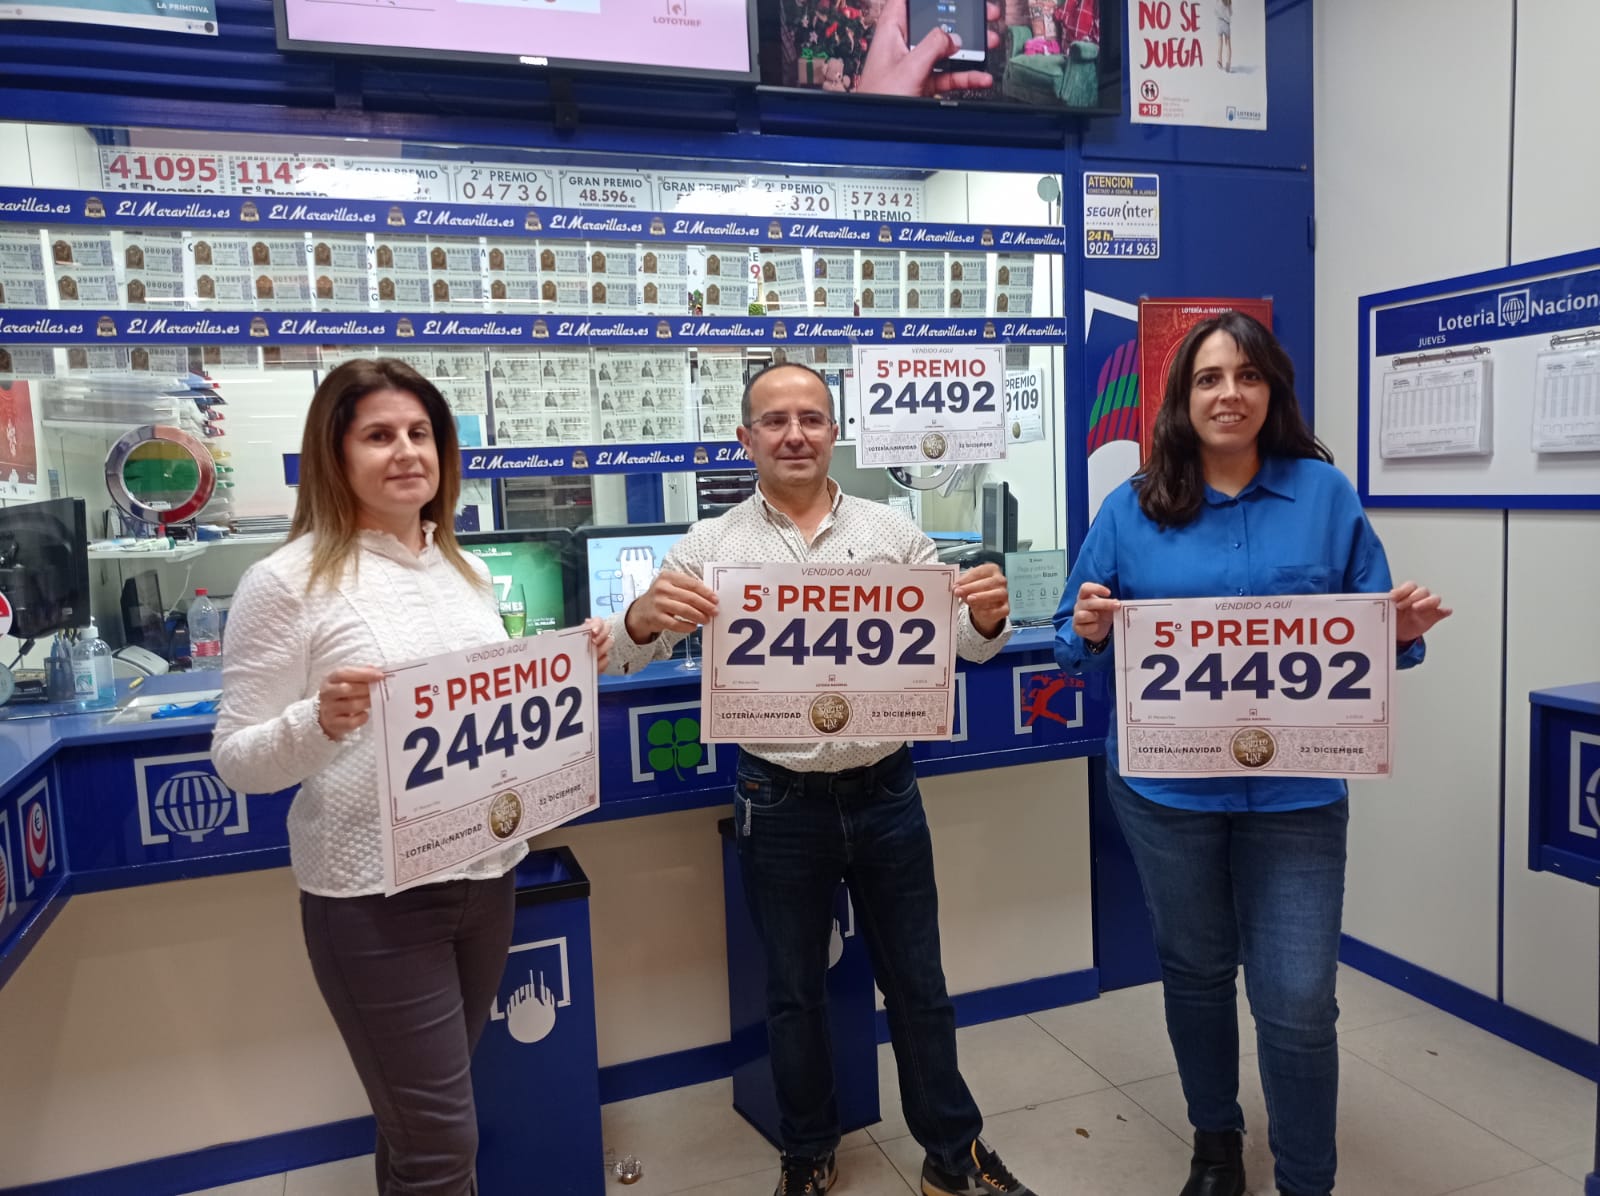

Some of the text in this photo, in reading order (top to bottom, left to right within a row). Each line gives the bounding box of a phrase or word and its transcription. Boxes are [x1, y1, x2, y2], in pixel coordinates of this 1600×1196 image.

[169, 3, 209, 14] PRIMITIVA
[1138, 0, 1201, 32] NO SE
[653, 16, 701, 27] LOTOTURF
[1140, 37, 1203, 69] JUEGA
[1141, 105, 1159, 115] +18
[109, 154, 217, 182] 41095
[490, 171, 538, 184] PREMIO
[569, 176, 642, 189] GRAN PREMIO
[1088, 176, 1133, 188] ATENCION
[463, 182, 548, 202] 04736
[662, 182, 695, 192] GRAN
[579, 189, 629, 203] 48.596
[851, 191, 913, 207] 57342
[116, 201, 231, 218] El Maravillas.es
[269, 205, 376, 223] El Maravillas.es
[864, 210, 912, 222] PREMIO
[414, 210, 515, 228] El Maravillas.es
[550, 215, 642, 233] El Maravillas.es
[673, 220, 759, 236] El Maravillas.es
[789, 224, 870, 240] El Maravillas.es
[899, 228, 975, 243] El Maravillas.es
[1088, 231, 1101, 240] 24
[1000, 231, 1014, 244] El
[1089, 242, 1156, 255] 902 114 963
[127, 318, 240, 335] El Maravillas.es
[278, 320, 385, 335] El Maravillas.es
[422, 321, 522, 335] El Maravillas.es
[1438, 309, 1495, 332] Loteria
[557, 323, 649, 337] El Maravillas.es
[679, 323, 765, 337] El Maravillas.es
[794, 324, 874, 337] El Maravillas.es
[902, 324, 977, 337] El Maravillas.es
[1002, 323, 1015, 336] El
[1418, 335, 1446, 348] JUEVES
[898, 359, 986, 378] PREMIO
[1006, 374, 1036, 390] PREMIO
[869, 381, 996, 416] 24492
[468, 454, 564, 470] El Maravillas.es
[596, 450, 685, 466] El Maravillas.es
[716, 448, 730, 461] El
[801, 567, 872, 577] VENDIDO AQUÍ
[742, 584, 925, 613] 5º PREMIO
[1215, 600, 1293, 611] VENDIDO AQUÍ
[1154, 617, 1355, 648] 5º PREMIO
[726, 618, 936, 666] 24492
[465, 641, 528, 664] VENDIDO AQUÍ
[1140, 651, 1371, 700] 24492
[414, 653, 571, 719] 5º PREMIO
[764, 711, 802, 719] NAVIDAD
[883, 710, 926, 718] DICIEMBRE
[402, 686, 584, 791] 24492
[1183, 746, 1222, 754] NAVIDAD
[549, 784, 582, 802] DICIEMBRE
[449, 823, 483, 842] NAVIDAD
